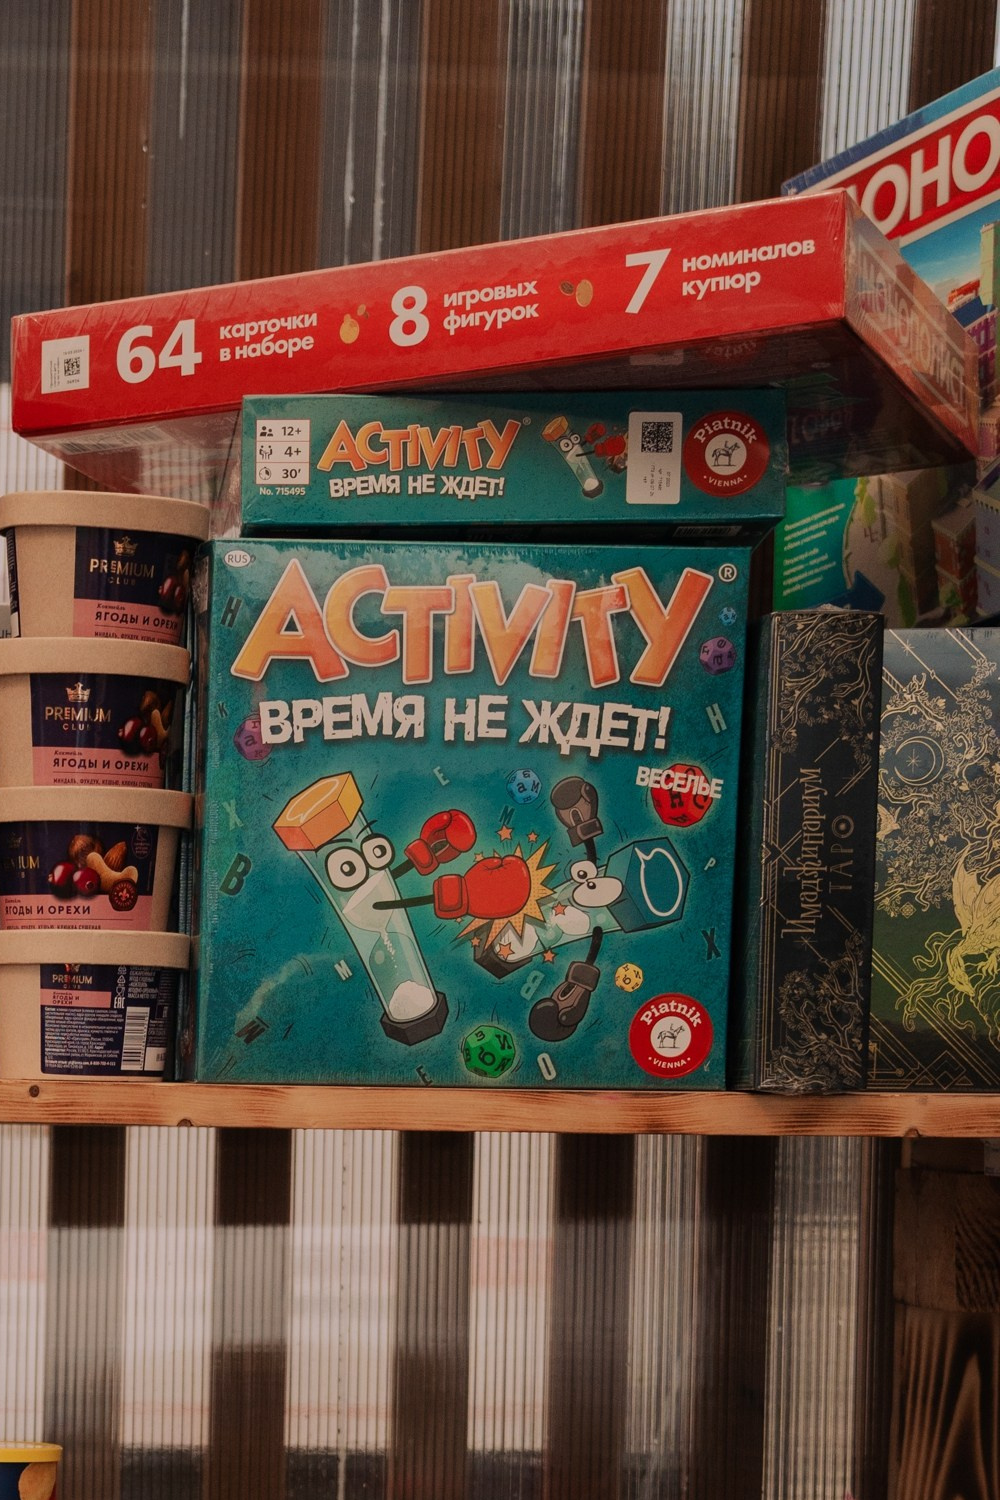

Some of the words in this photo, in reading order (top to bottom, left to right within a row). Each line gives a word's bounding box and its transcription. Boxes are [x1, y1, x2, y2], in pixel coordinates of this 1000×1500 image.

[847, 113, 1000, 236] ОНО
[682, 239, 816, 273] номиналов
[625, 247, 672, 314] 7
[682, 269, 761, 300] купюр
[443, 280, 539, 310] игровых
[219, 311, 317, 340] карточки
[389, 285, 430, 347] 8
[443, 303, 540, 336] фигурок
[116, 318, 202, 385] 64
[219, 346, 232, 362] в
[234, 334, 315, 362] наборе
[281, 426, 302, 437] 12+
[693, 416, 758, 444] Piatnik
[284, 446, 302, 458] 4+
[317, 419, 521, 472] ACTIVITY
[259, 487, 274, 496] No.
[275, 487, 306, 496] 715495
[329, 474, 401, 498] ВРЕМЯ
[407, 474, 436, 495] НЕ
[440, 475, 505, 500] ЖДЕТ!
[708, 476, 744, 487] VIENNA
[89, 558, 155, 579] PREMIUM
[228, 553, 249, 565] RUS
[95, 611, 139, 624] ЯГОДЫ
[142, 616, 150, 625] И
[153, 618, 179, 630] ОРЕХИ
[230, 557, 715, 689] ACTIVITY
[45, 706, 112, 722] PREMIUM
[258, 691, 426, 746] ВРЕМЯ
[443, 697, 508, 743] НЕ
[520, 698, 672, 757] ЖДЕТ!
[53, 758, 97, 769] ЯГОДЫ
[102, 759, 110, 769] И
[115, 760, 149, 772] ОРЕХИ
[635, 766, 724, 799] ВЕСЕЛЬЕ
[780, 767, 828, 939] Имаджинариум
[5, 905, 33, 915] ЯГОДЫ
[36, 906, 44, 915] И
[48, 905, 91, 915] ОРЕХИ
[52, 974, 93, 985] PREMIUM
[640, 1000, 702, 1028] Piatnik
[652, 1057, 689, 1070] VIENNA
